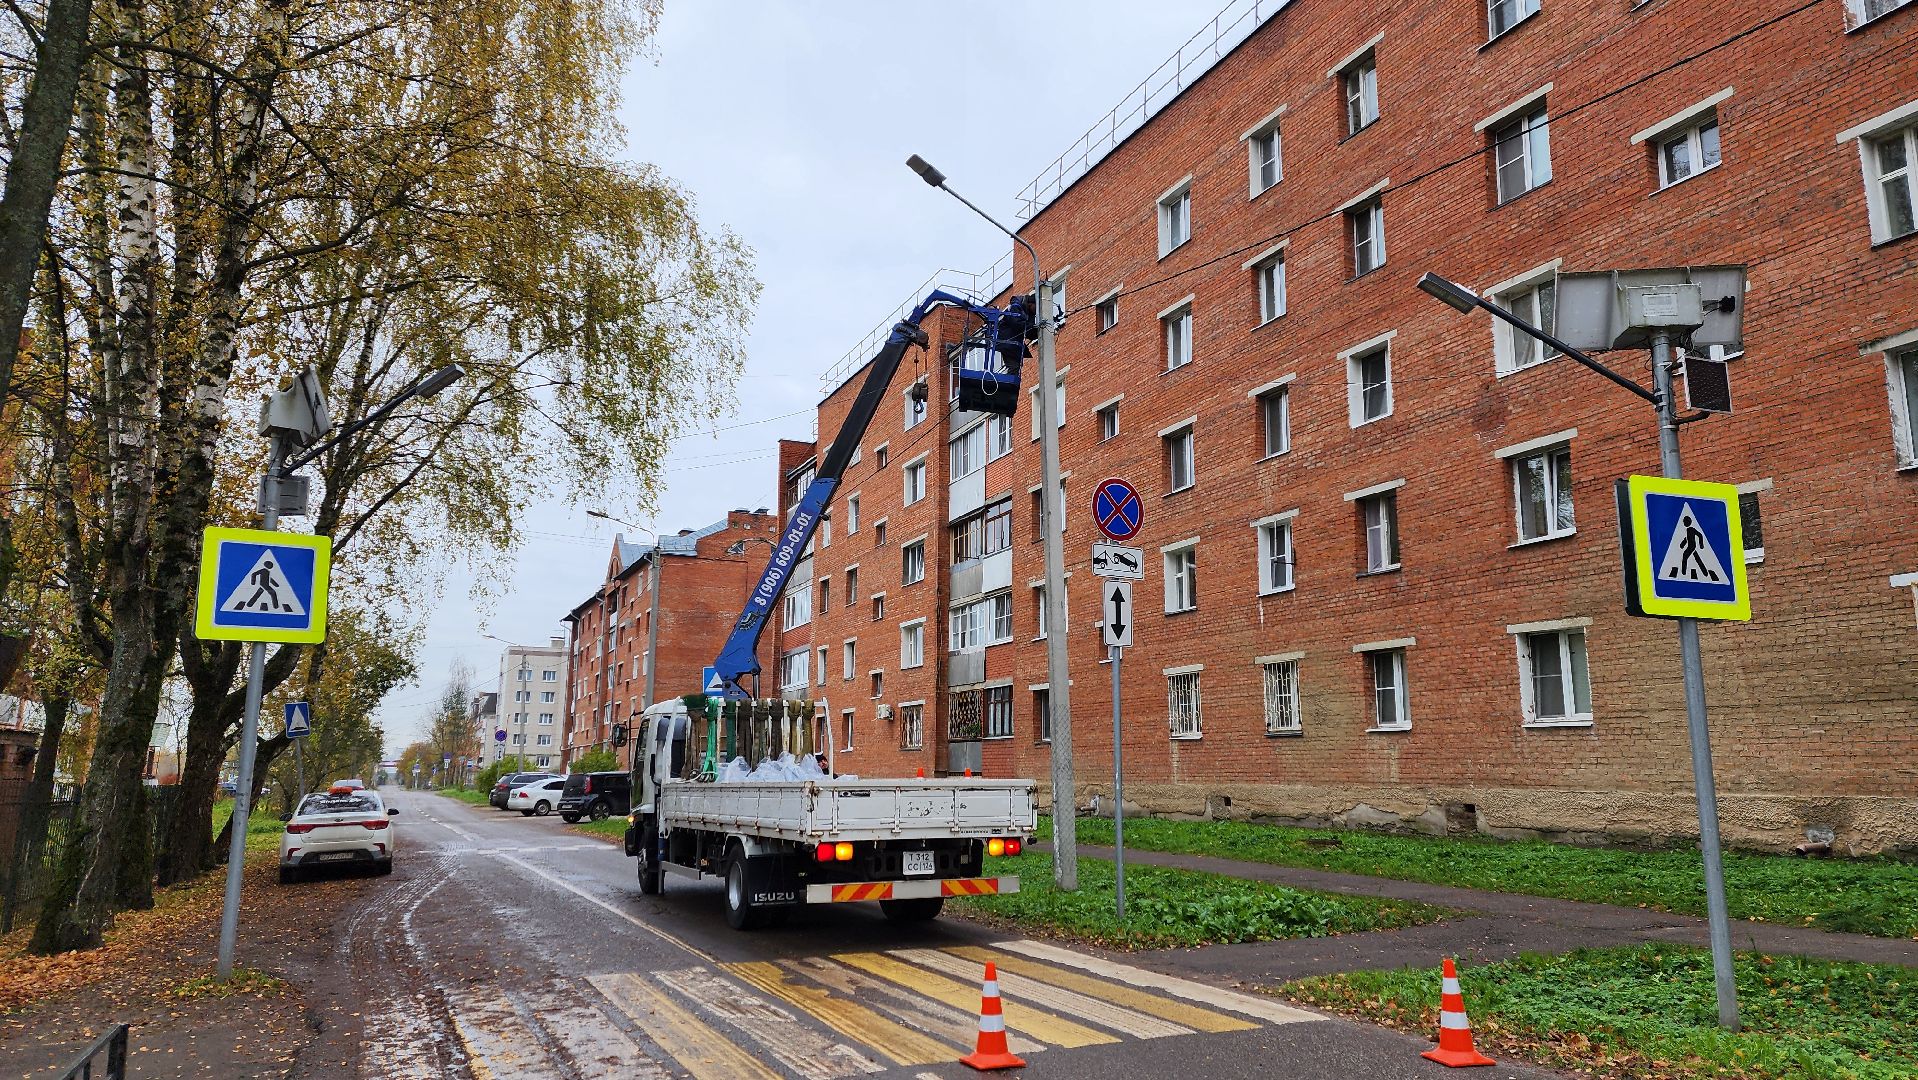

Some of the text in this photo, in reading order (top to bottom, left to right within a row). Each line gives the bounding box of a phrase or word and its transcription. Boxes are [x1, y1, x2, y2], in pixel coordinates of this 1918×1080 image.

[754, 512, 813, 606] 8 (906) 609-01-01
[915, 853, 930, 861] 312
[754, 891, 795, 902] ISUZU
